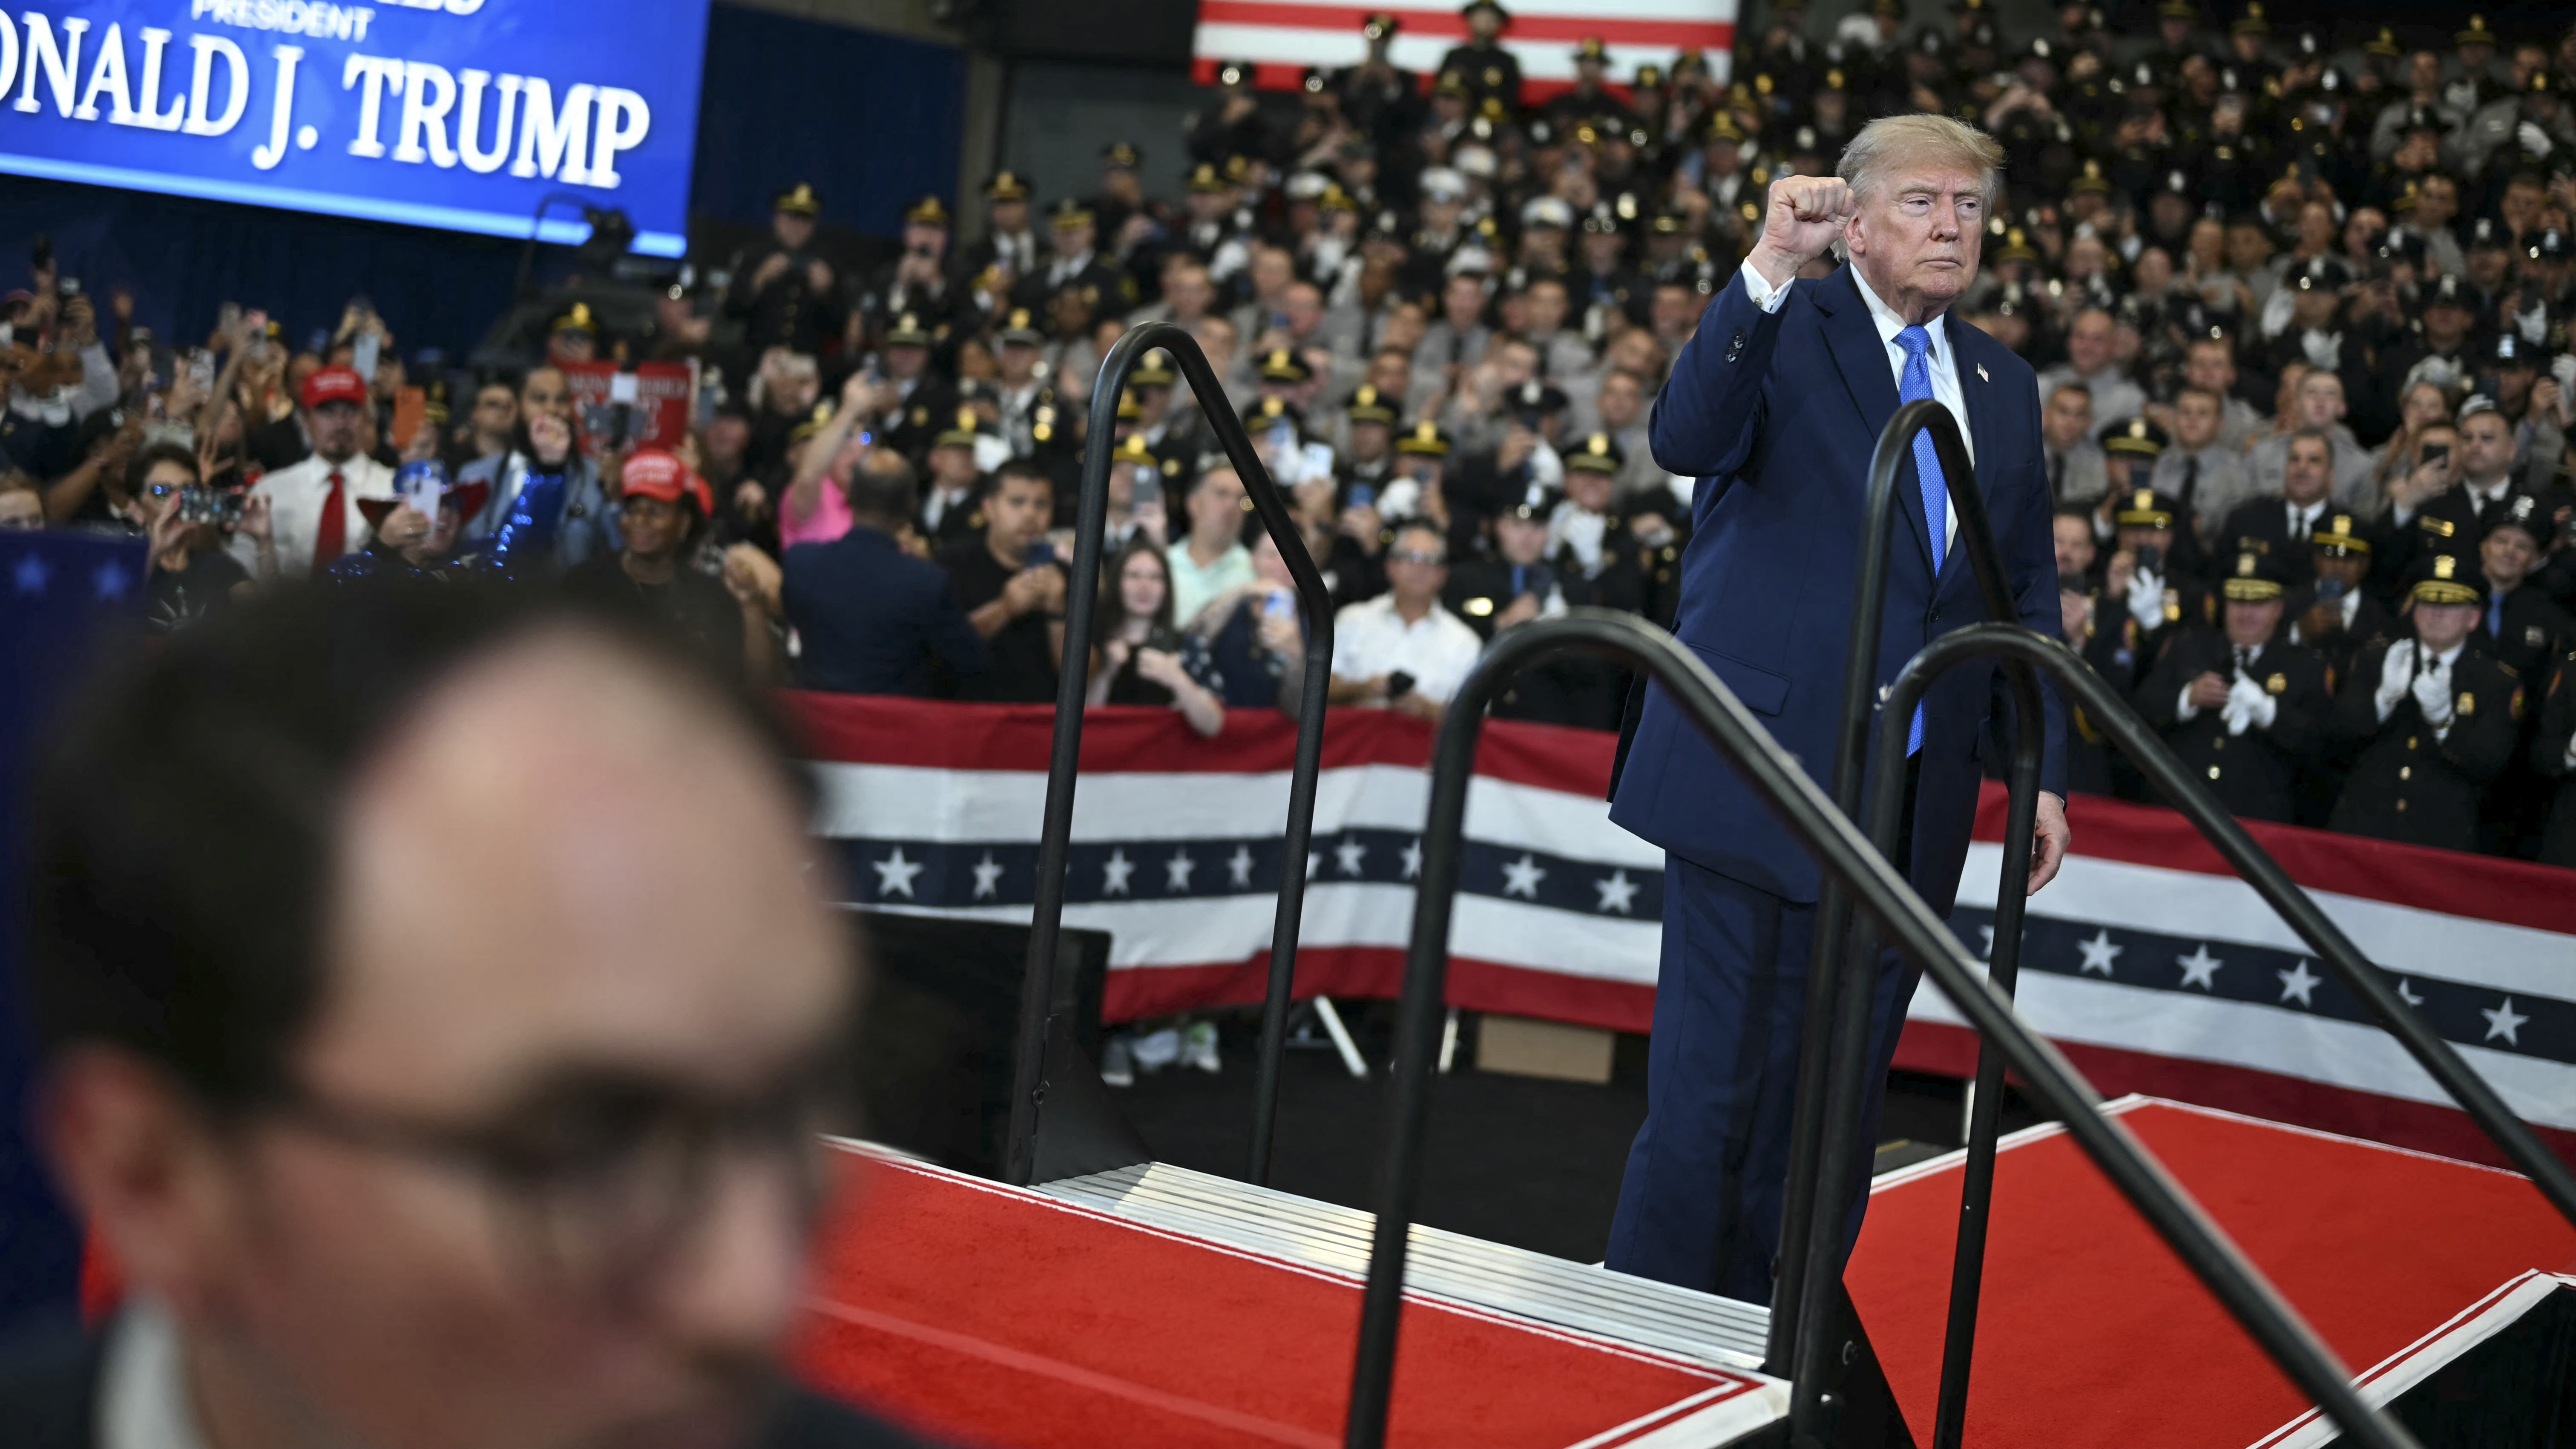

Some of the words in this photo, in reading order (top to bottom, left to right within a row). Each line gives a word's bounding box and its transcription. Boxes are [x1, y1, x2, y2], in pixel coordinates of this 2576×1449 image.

[191, 0, 375, 42] PRESIDENT
[252, 44, 318, 170] J.
[342, 52, 650, 189] TRUMP
